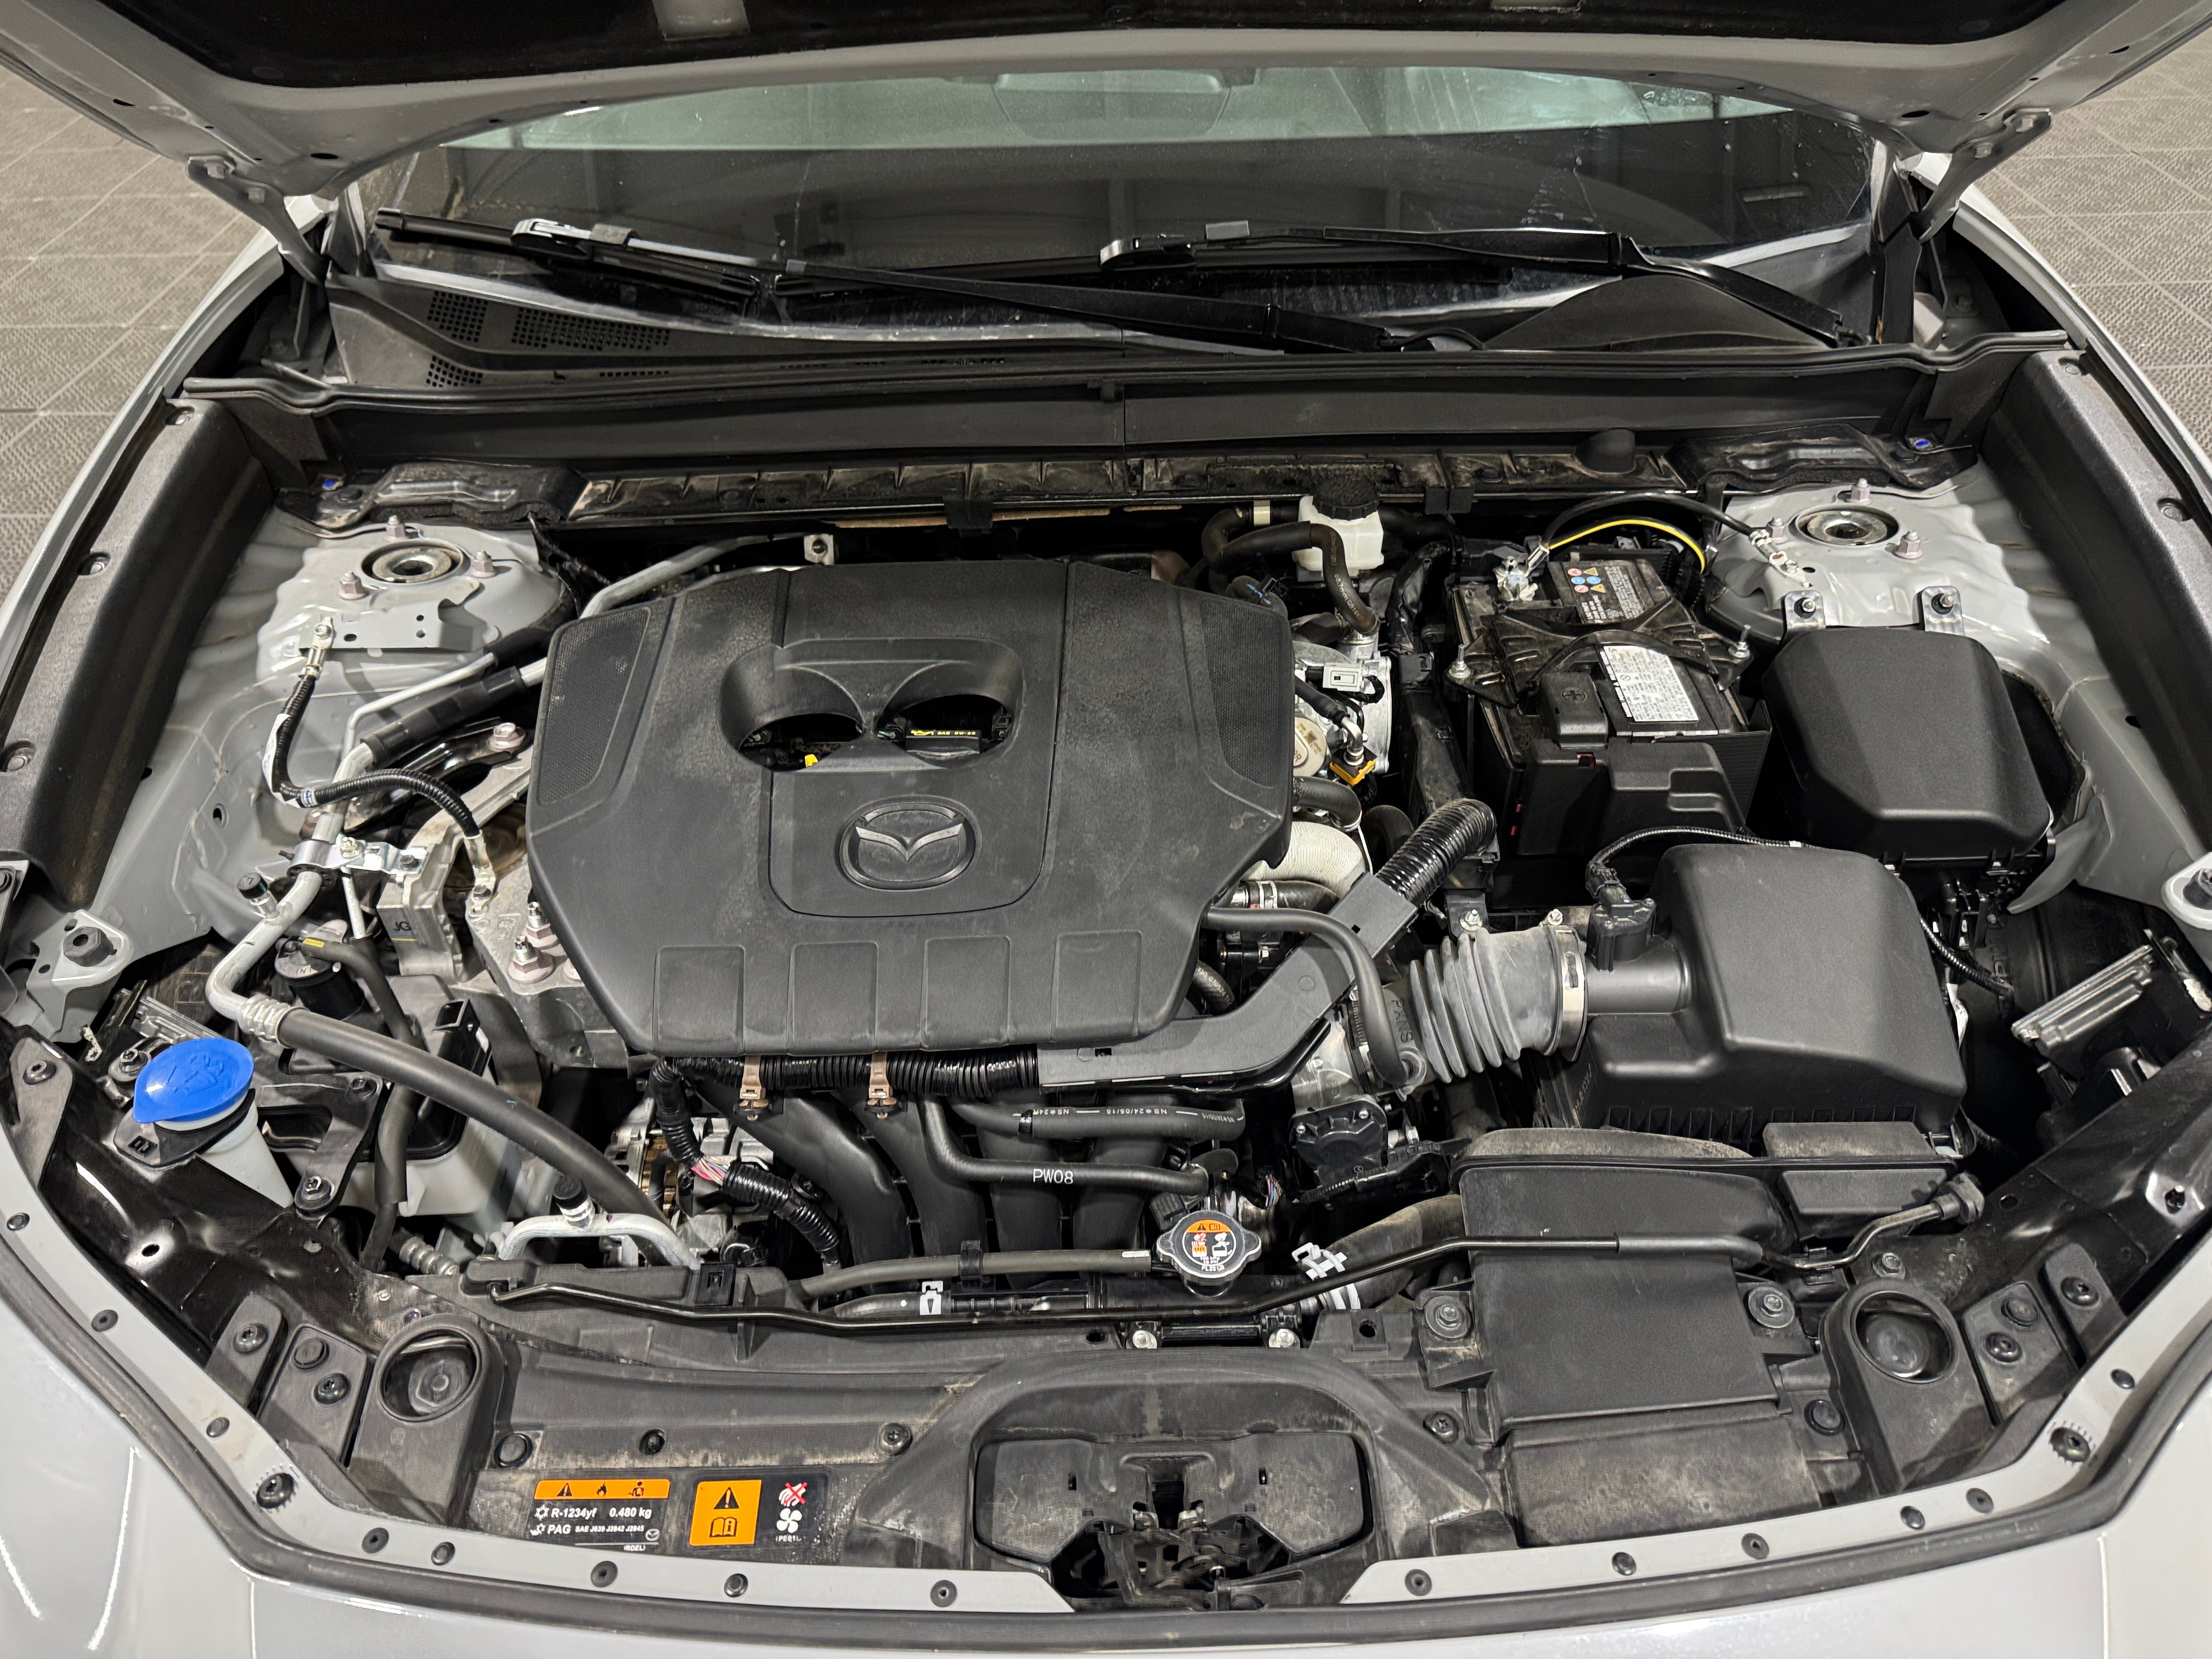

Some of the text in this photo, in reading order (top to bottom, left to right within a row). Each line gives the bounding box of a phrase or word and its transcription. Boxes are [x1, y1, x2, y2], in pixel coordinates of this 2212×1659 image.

[394, 921, 411, 931] JG
[1391, 998, 1413, 1042] PXNS
[1032, 1168, 1074, 1185] PW08
[551, 1507, 652, 1520] R-1234yf 0.480 kg
[548, 1524, 571, 1534] PAG
